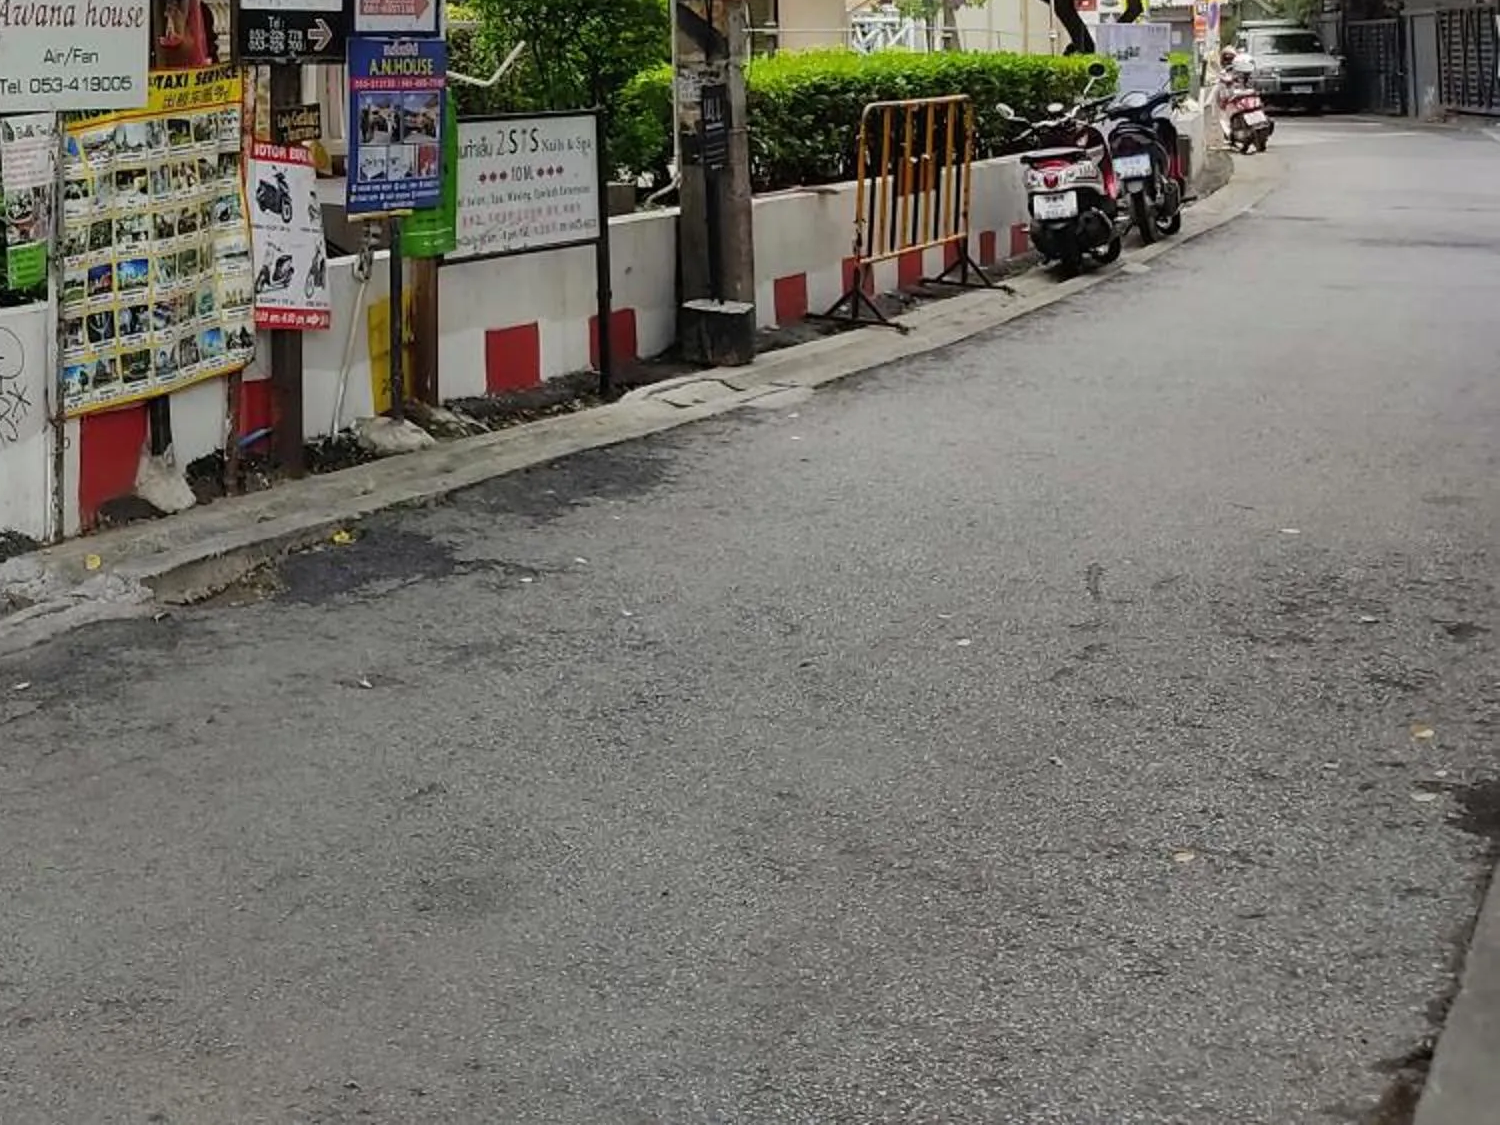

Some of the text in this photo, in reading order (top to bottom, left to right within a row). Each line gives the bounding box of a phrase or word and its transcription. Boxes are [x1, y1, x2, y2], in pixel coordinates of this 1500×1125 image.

[43, 47, 99, 67] Air/Fan
[369, 58, 434, 76] A.N.HOUSE
[155, 74, 189, 91] TAXI
